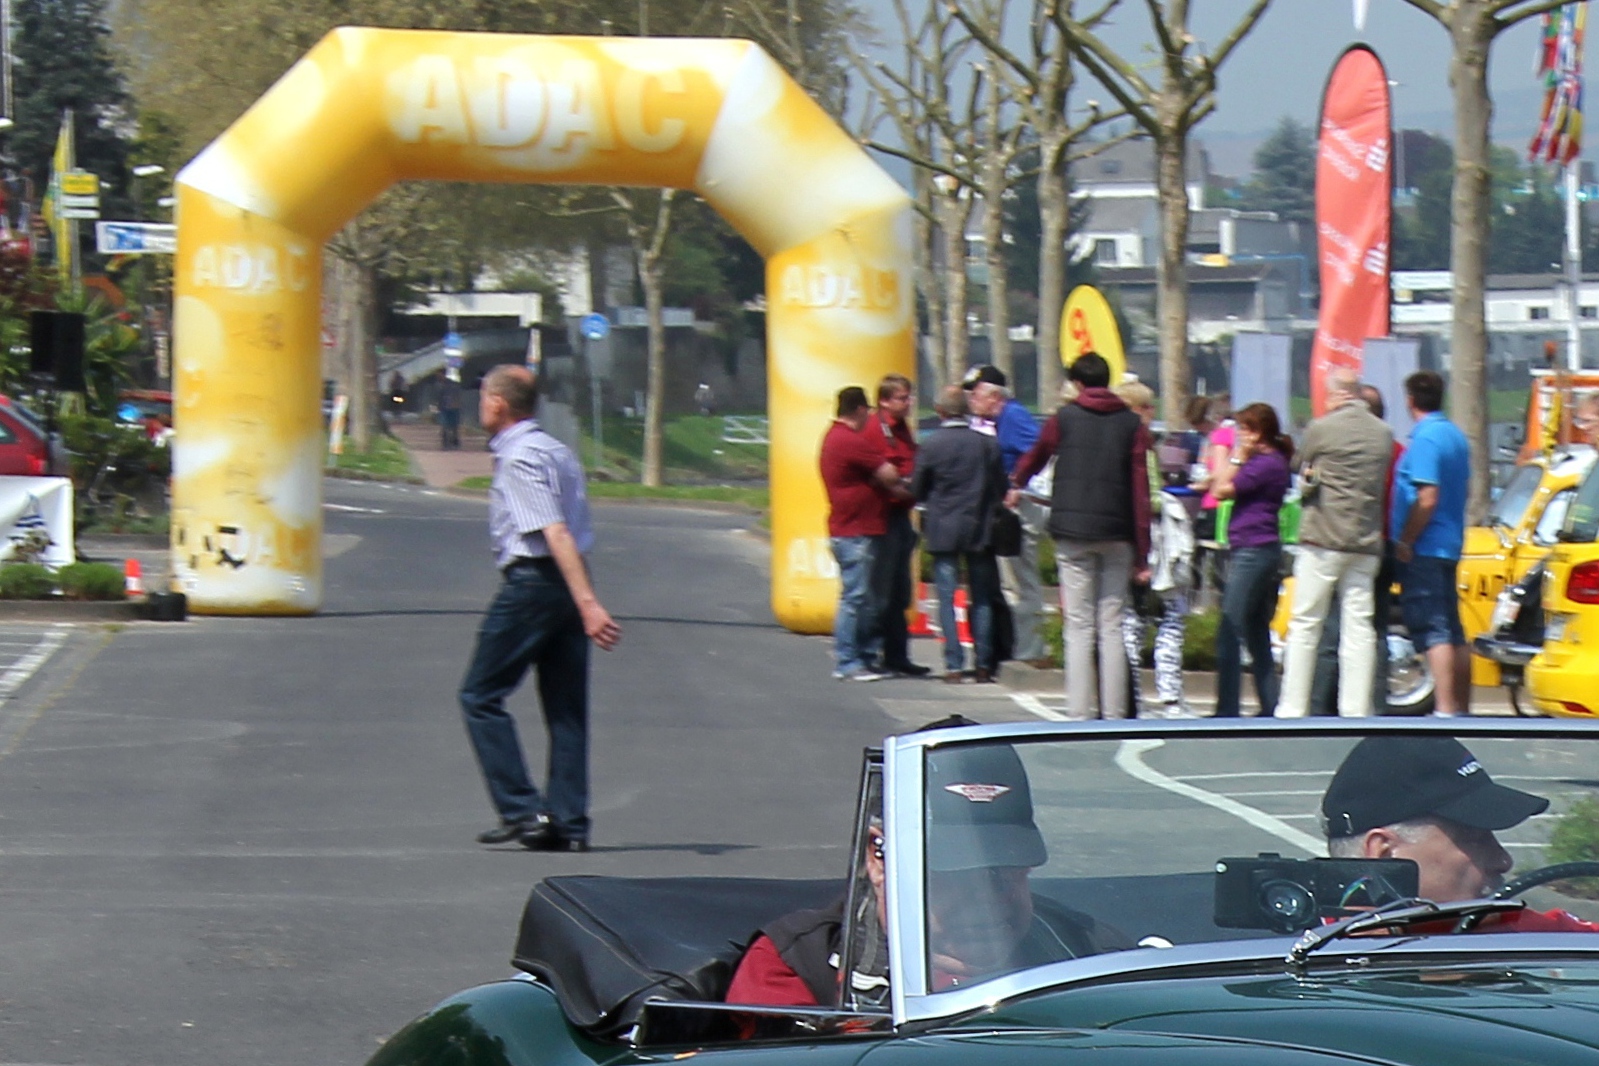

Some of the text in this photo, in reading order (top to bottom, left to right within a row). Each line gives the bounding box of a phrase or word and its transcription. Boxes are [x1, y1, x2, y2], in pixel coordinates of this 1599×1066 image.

[386, 53, 689, 153] ADAC
[193, 243, 308, 292] ADAC
[781, 264, 899, 311] ADAC
